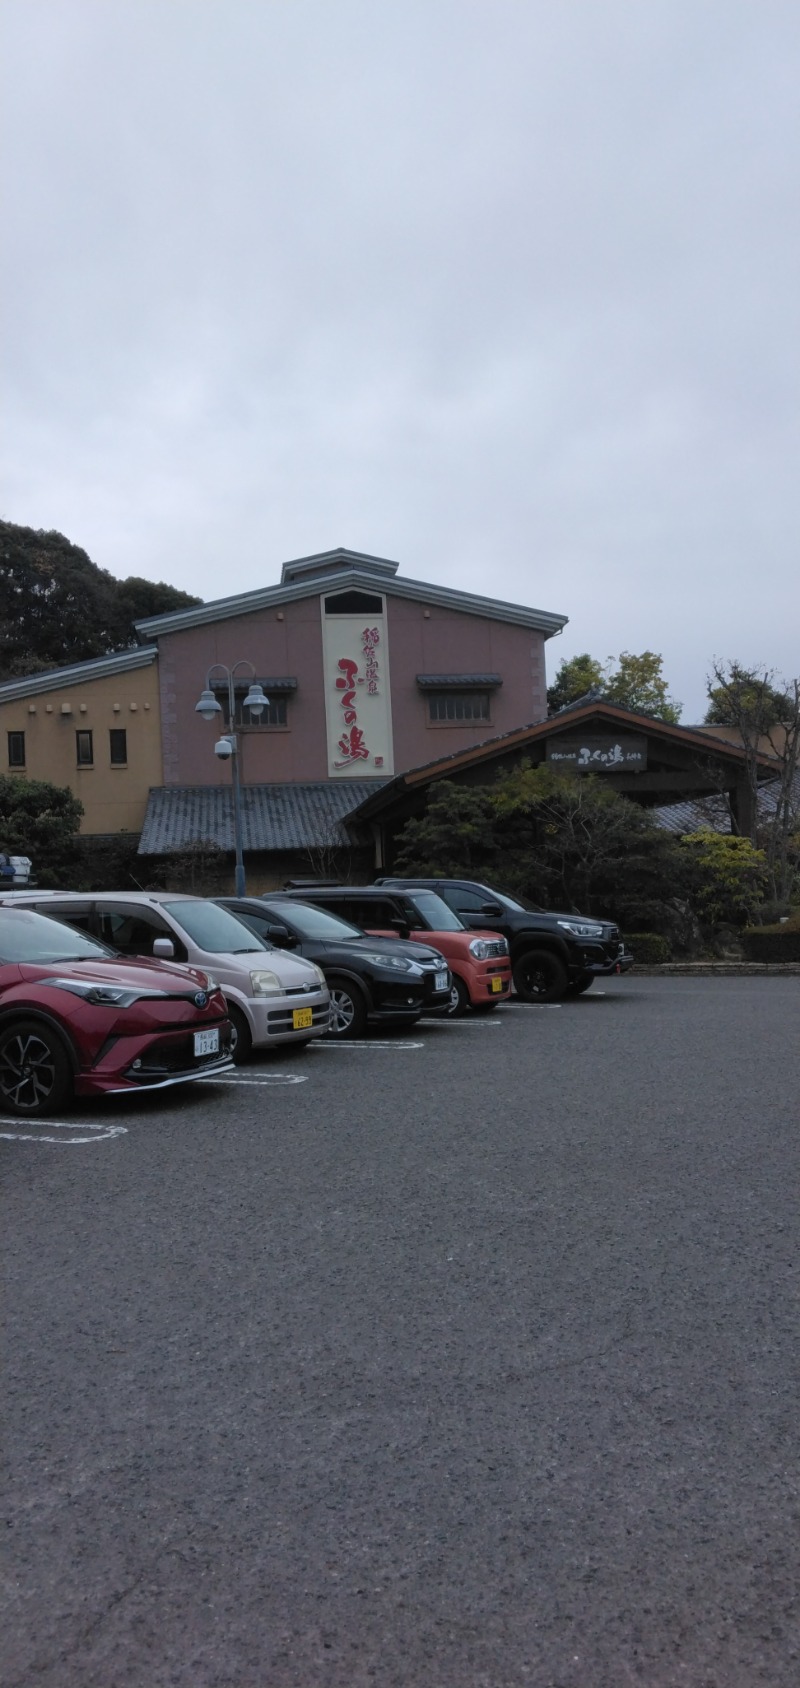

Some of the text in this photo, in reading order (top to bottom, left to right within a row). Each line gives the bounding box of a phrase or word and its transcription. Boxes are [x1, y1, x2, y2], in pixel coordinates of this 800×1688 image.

[361, 627, 380, 694] 稲佐山温泉
[333, 657, 370, 769] ふくの湯
[578, 743, 625, 767] ふくの湯
[199, 1038, 218, 1054] 13-43
